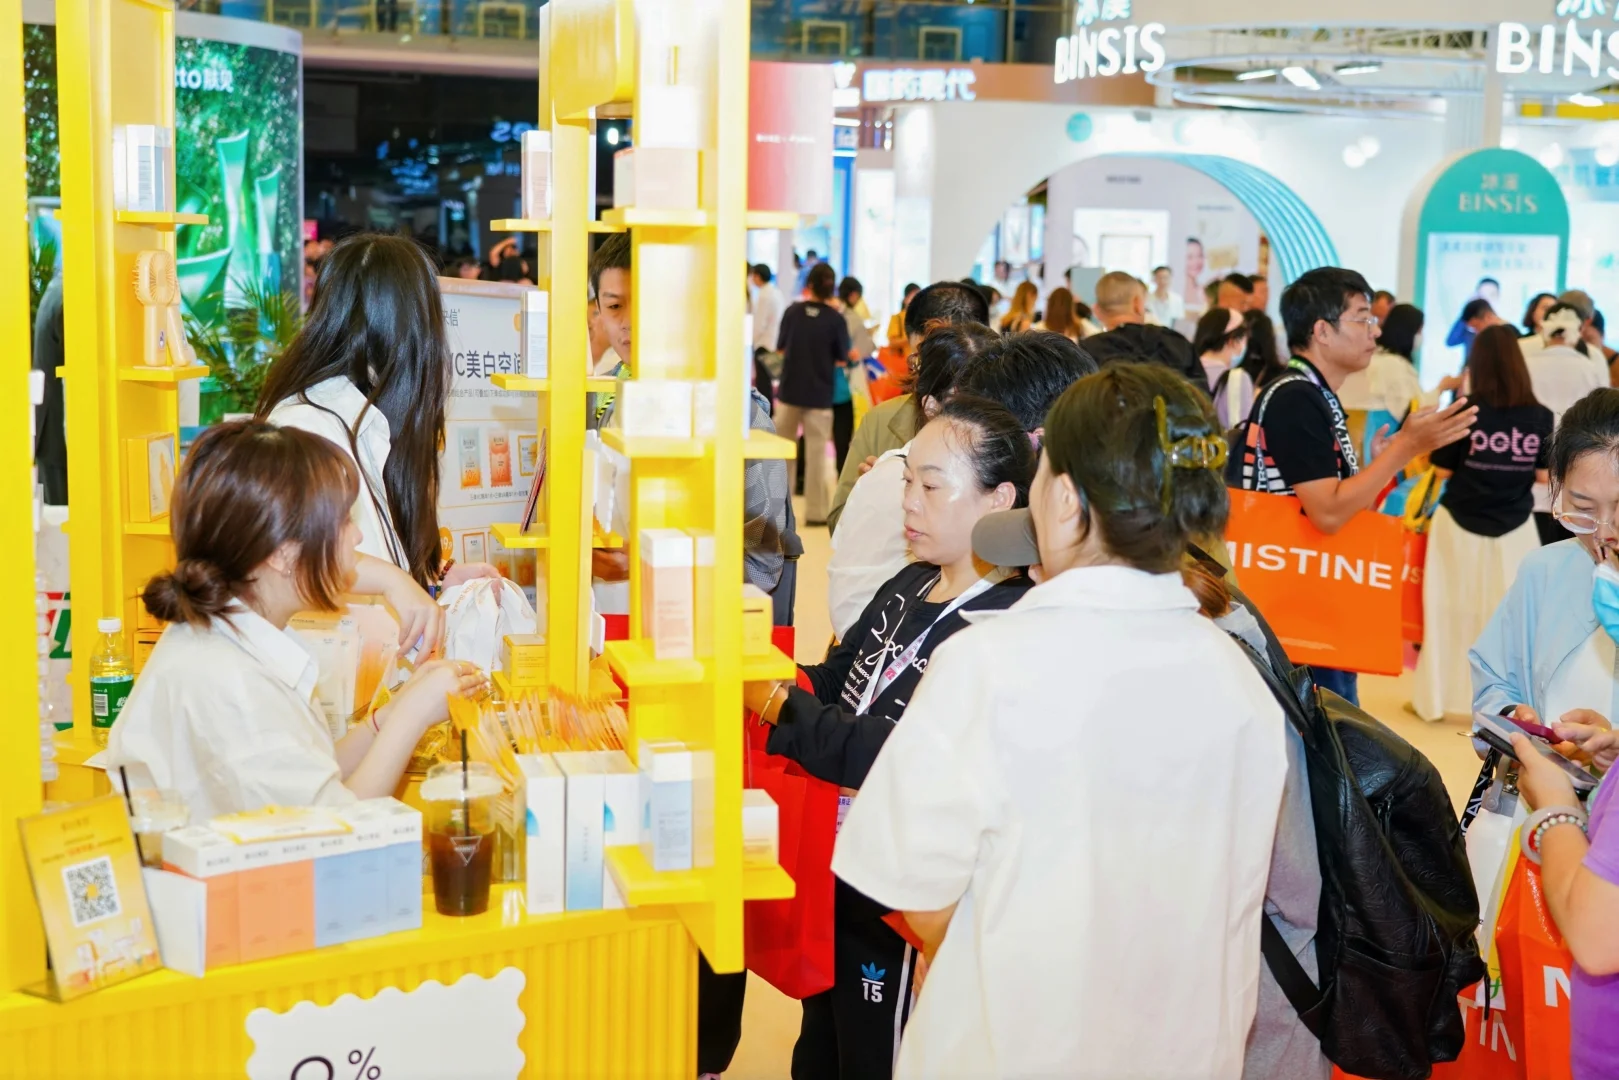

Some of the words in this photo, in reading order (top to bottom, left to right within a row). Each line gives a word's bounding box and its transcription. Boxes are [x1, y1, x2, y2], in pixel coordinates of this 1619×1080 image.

[1054, 22, 1166, 84] BINSIS
[1458, 192, 1538, 214] BINSIS
[1469, 426, 1540, 456] pote
[862, 982, 883, 1003] 15
